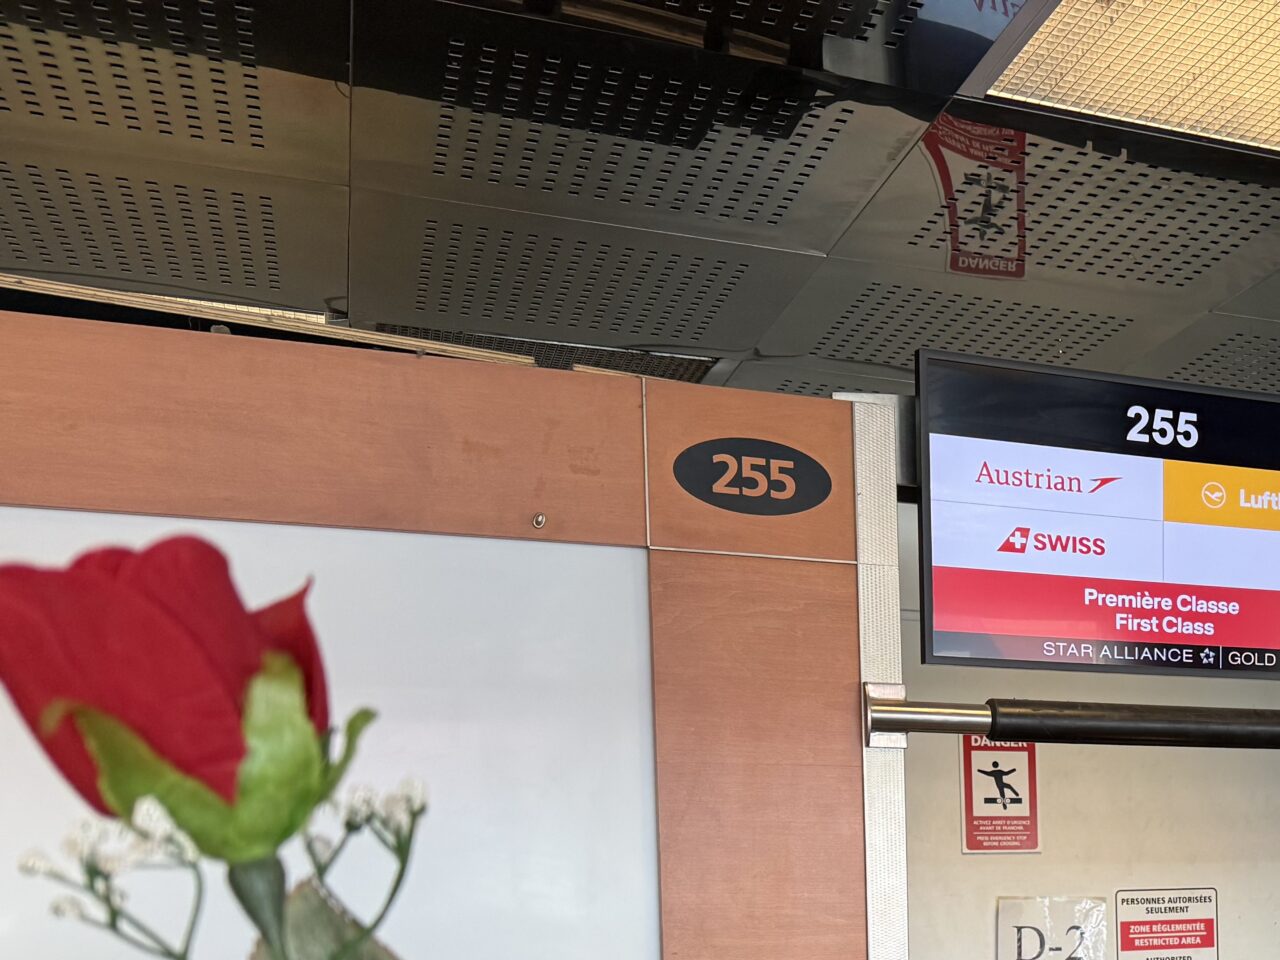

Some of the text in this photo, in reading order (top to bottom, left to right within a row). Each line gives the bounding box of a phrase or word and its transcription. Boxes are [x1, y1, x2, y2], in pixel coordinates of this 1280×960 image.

[1126, 405, 1199, 449] 255
[712, 453, 796, 500] 255
[975, 461, 1083, 493] Austrian
[1033, 533, 1106, 556] SWISS
[1083, 588, 1240, 615] Première Classe
[1115, 614, 1215, 636] First Class
[1043, 641, 1276, 667] STAR ALLIANCE GOLD
[1121, 894, 1212, 906] PERSONNES AUTORISÉES
[1145, 906, 1190, 914] SEULEMENT
[1129, 922, 1205, 933] ZONE RÉGLEMENTÉE
[1134, 936, 1202, 947] RESTRICTED AREA
